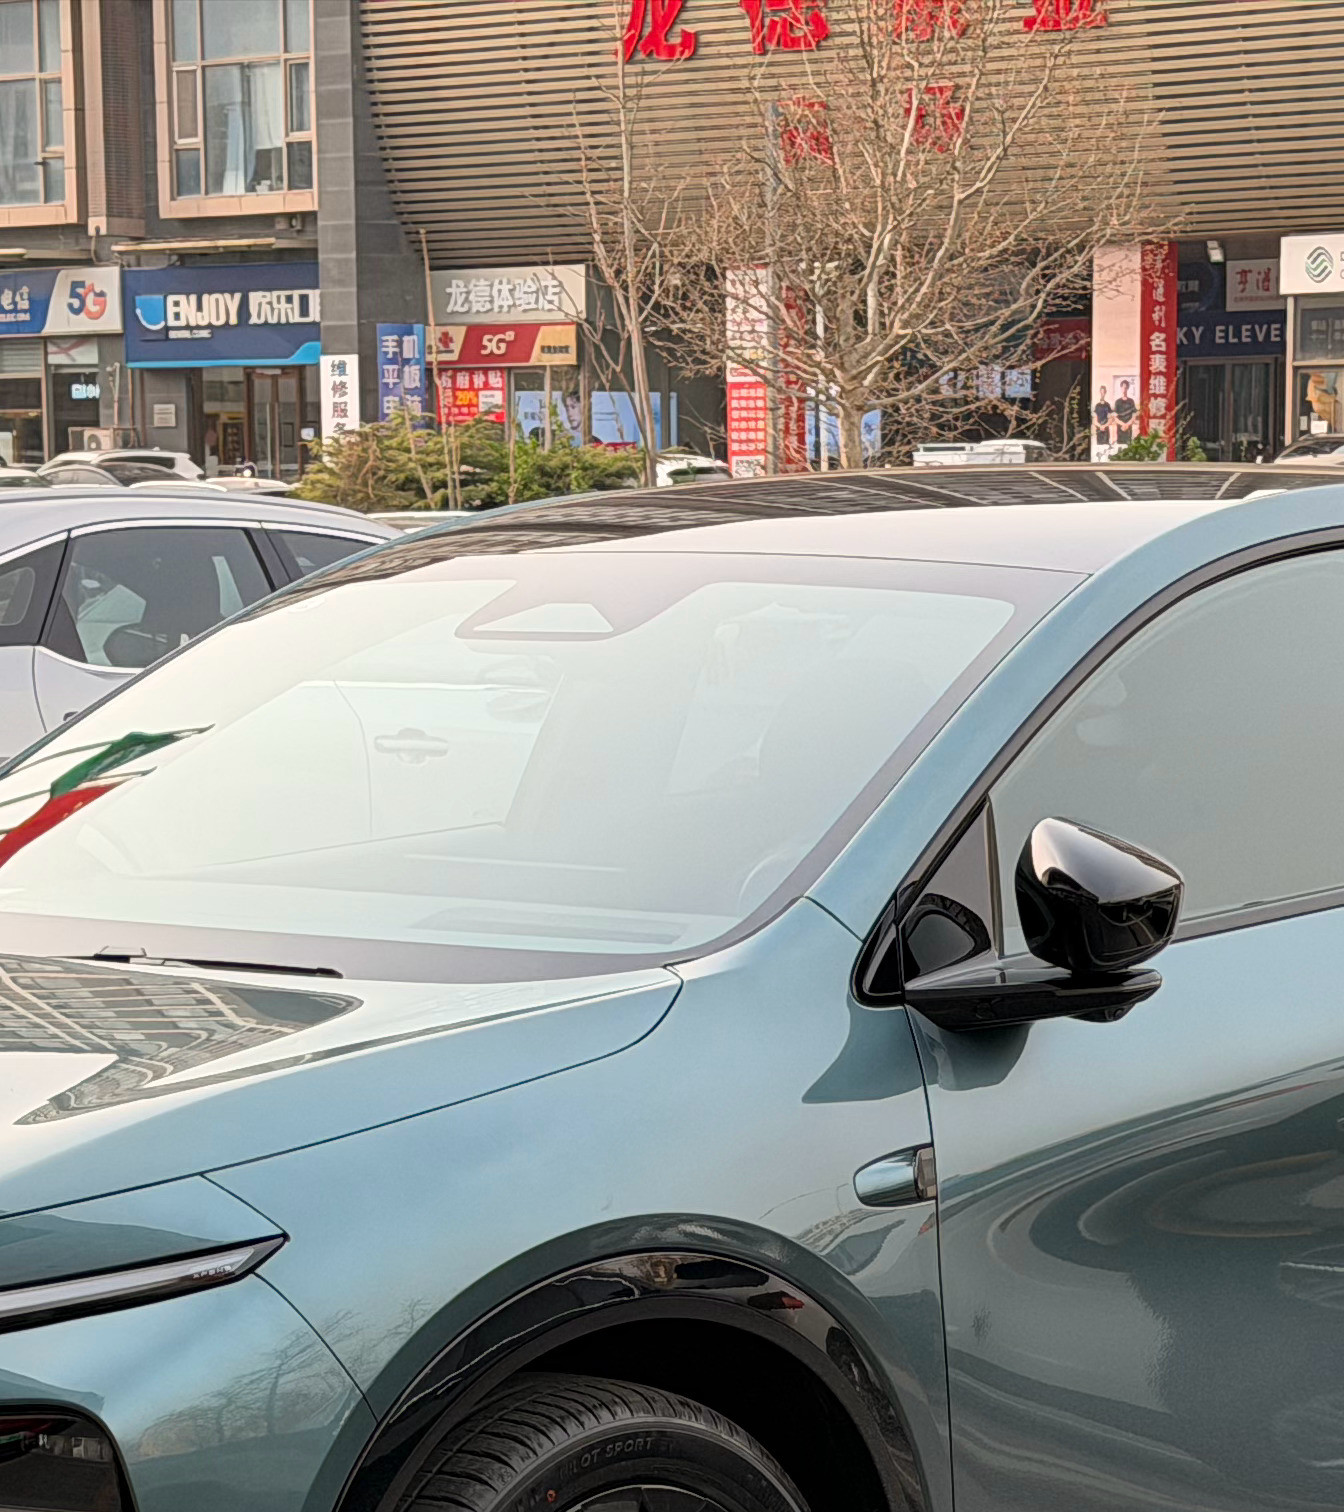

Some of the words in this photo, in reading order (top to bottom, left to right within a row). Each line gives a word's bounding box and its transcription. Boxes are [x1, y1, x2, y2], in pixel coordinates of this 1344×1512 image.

[67, 280, 108, 320] 5G
[167, 293, 242, 327] ENJOY
[248, 289, 320, 325] 欢乐口
[445, 277, 561, 314] 龙德体验店
